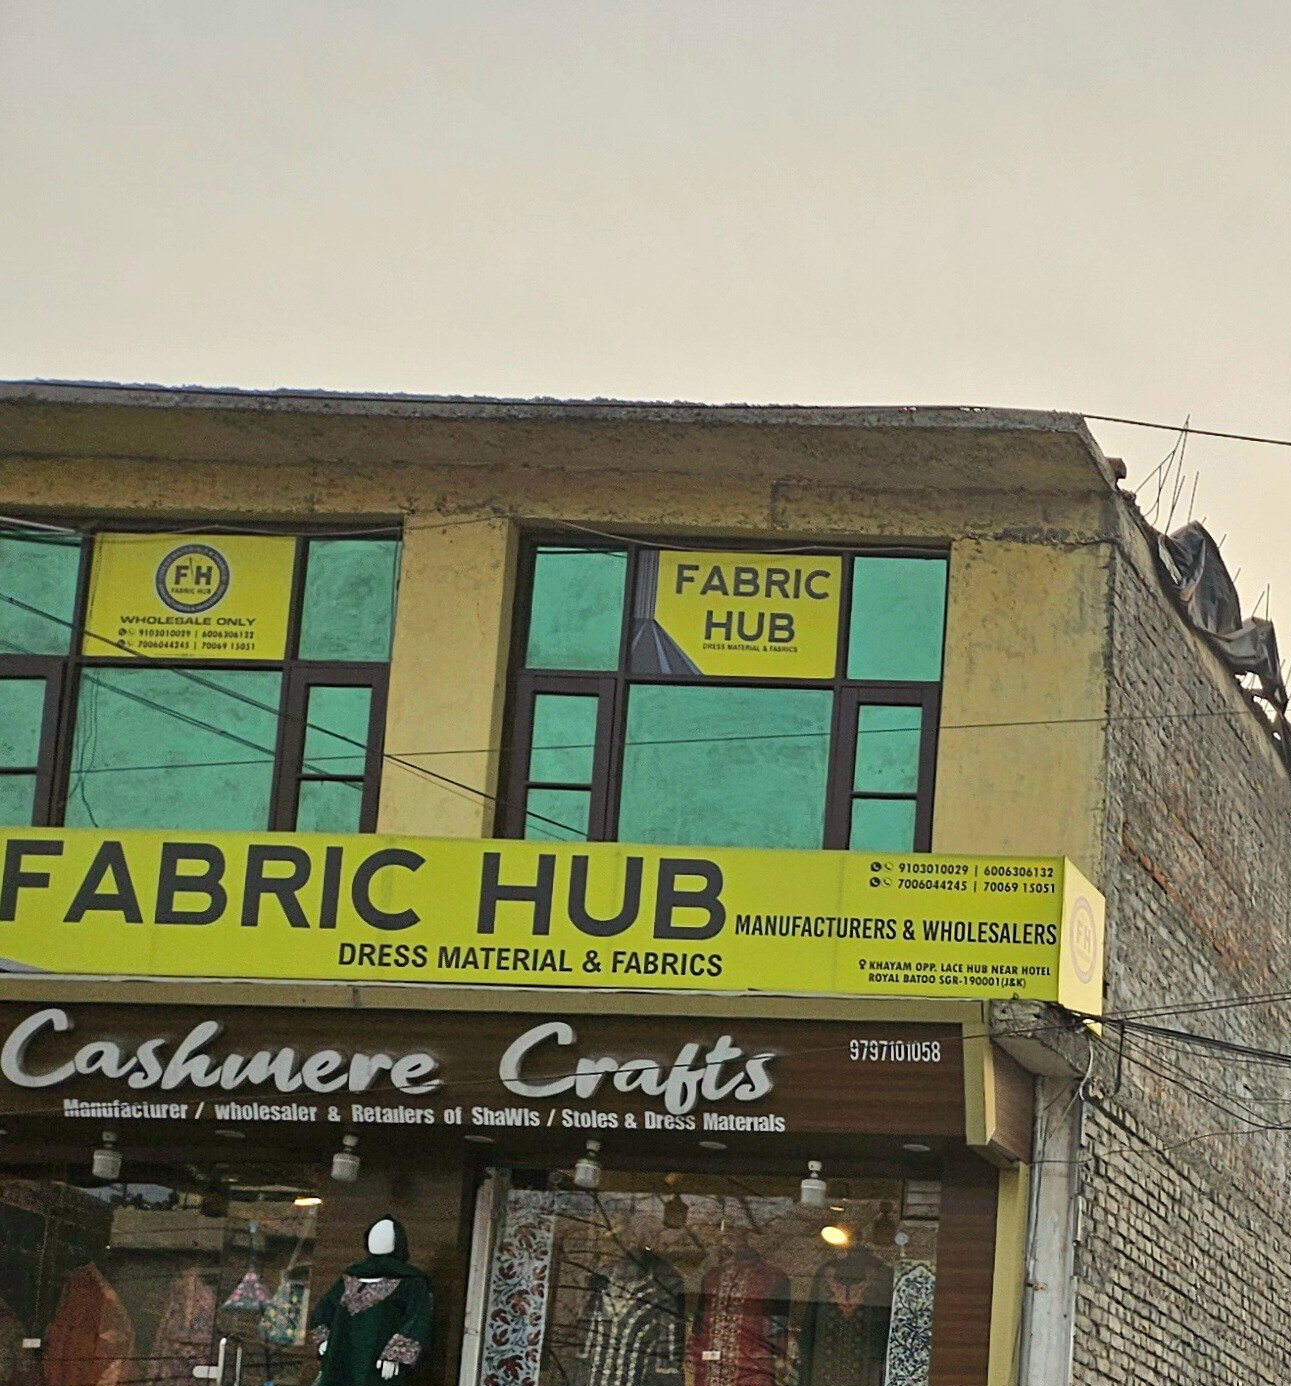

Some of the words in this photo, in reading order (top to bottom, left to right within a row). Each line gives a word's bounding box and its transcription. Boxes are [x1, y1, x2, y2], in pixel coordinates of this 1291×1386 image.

[676, 563, 832, 600] FABRIC
[120, 615, 211, 626] WHOLESALE
[216, 617, 256, 626] ONLY
[704, 610, 796, 643] HUB
[703, 643, 725, 651] DRESS
[727, 644, 761, 652] MATERIAL
[769, 645, 798, 653] FABRICS
[898, 862, 969, 875] 9103010029
[984, 866, 1054, 878] 6006306132
[0, 838, 426, 931] FABRIC
[477, 851, 727, 941] HUB
[898, 878, 967, 891] 7006044245
[983, 881, 1018, 893] 70069
[1023, 882, 1055, 894] 15051
[735, 914, 897, 941] MANUFACTURERS
[902, 919, 916, 941] &
[922, 920, 1058, 946] WHOLESALERS
[338, 942, 428, 968] DRESS
[437, 945, 572, 973] MATERIAL
[581, 950, 602, 974] &
[612, 950, 723, 977] FABRICS
[869, 960, 912, 971] KHAYAM
[941, 963, 963, 973] LACE
[967, 964, 988, 974] HUB
[991, 965, 1018, 975] NEAR
[1022, 966, 1051, 976] HOTEL
[869, 972, 899, 983] ROYAL
[903, 974, 936, 984] BATOO
[0, 1008, 443, 1095] Cashmere
[499, 1021, 775, 1115] Crafts
[849, 1039, 941, 1062] 9797101058
[63, 1098, 189, 1119] Manufacturer
[215, 1103, 317, 1122] wholesaler
[328, 1105, 341, 1122] &
[352, 1104, 434, 1124] Retailers
[444, 1105, 462, 1124] of
[562, 1110, 618, 1128] Stoles
[625, 1112, 637, 1128] &
[644, 1111, 696, 1131] Dress
[703, 1112, 786, 1132] Materials
